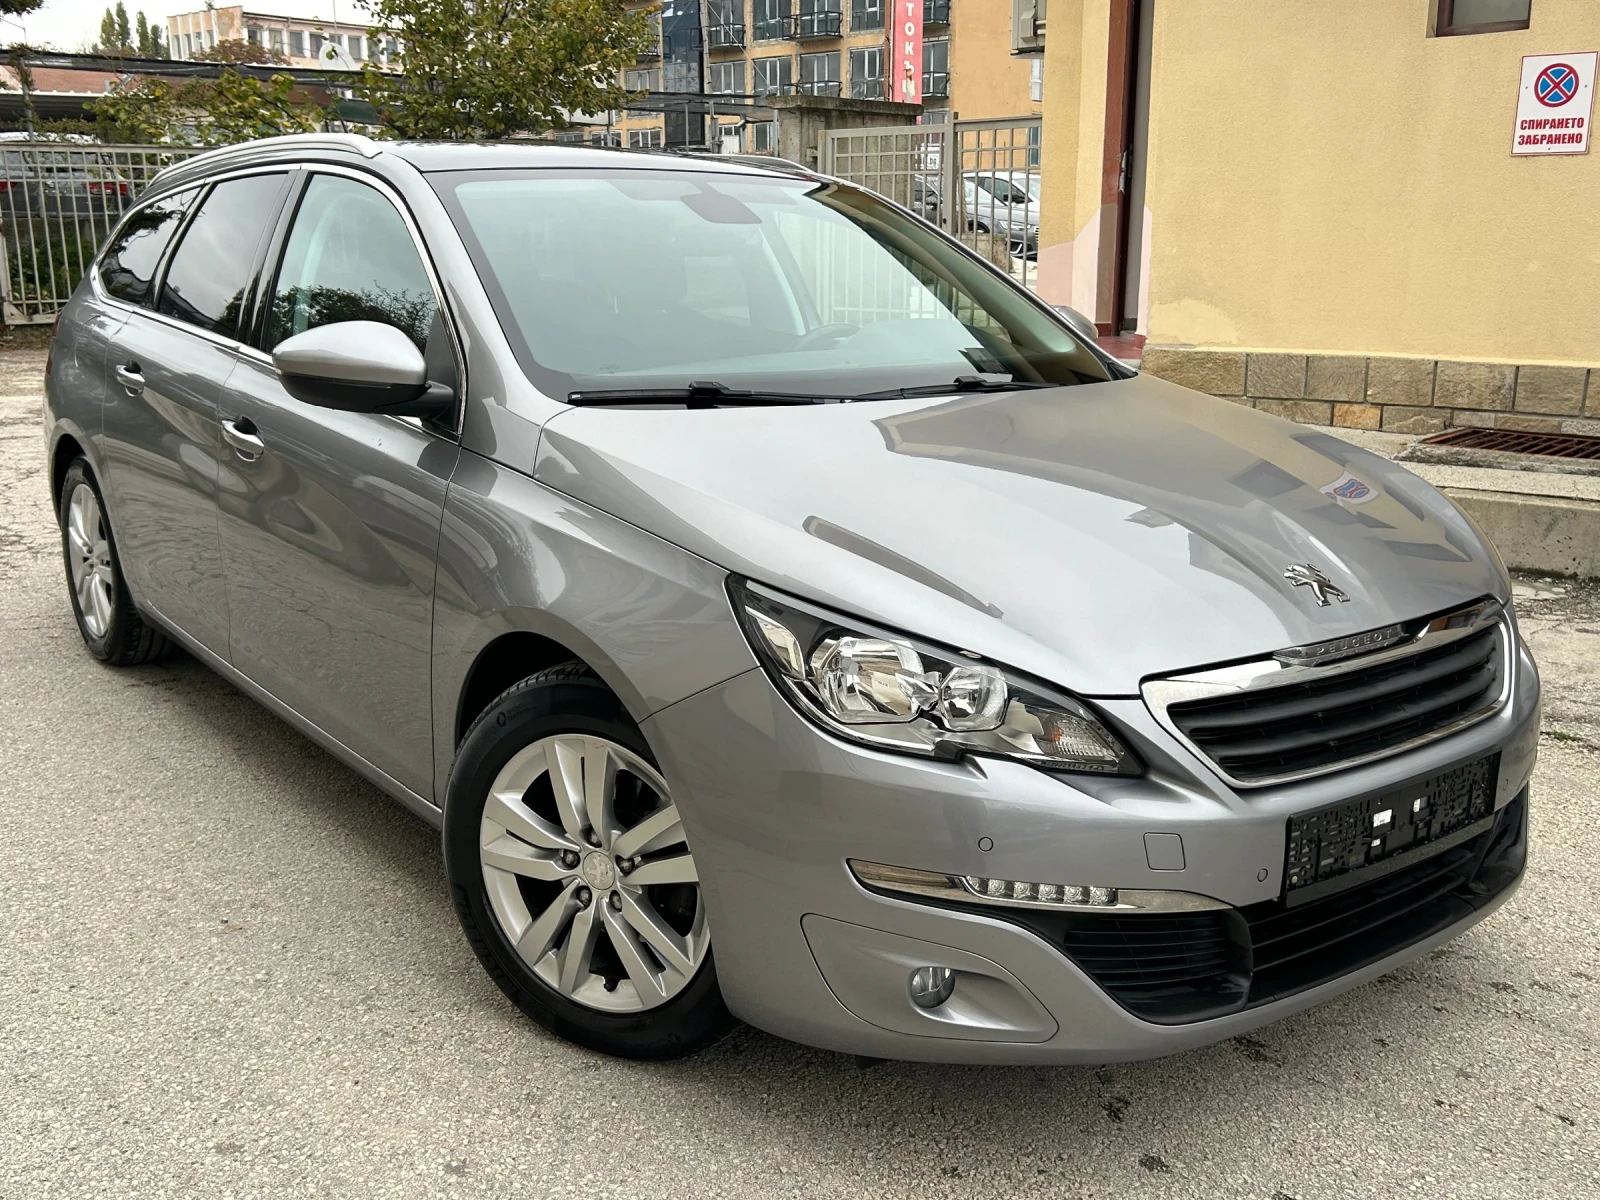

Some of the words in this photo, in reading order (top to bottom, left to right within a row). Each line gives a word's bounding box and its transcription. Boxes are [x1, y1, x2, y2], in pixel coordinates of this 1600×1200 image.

[1520, 117, 1585, 130] СПИРАНЕТО
[1518, 133, 1583, 145] ЗАБРАНЕНО
[1316, 629, 1393, 656] PEUGEOT
